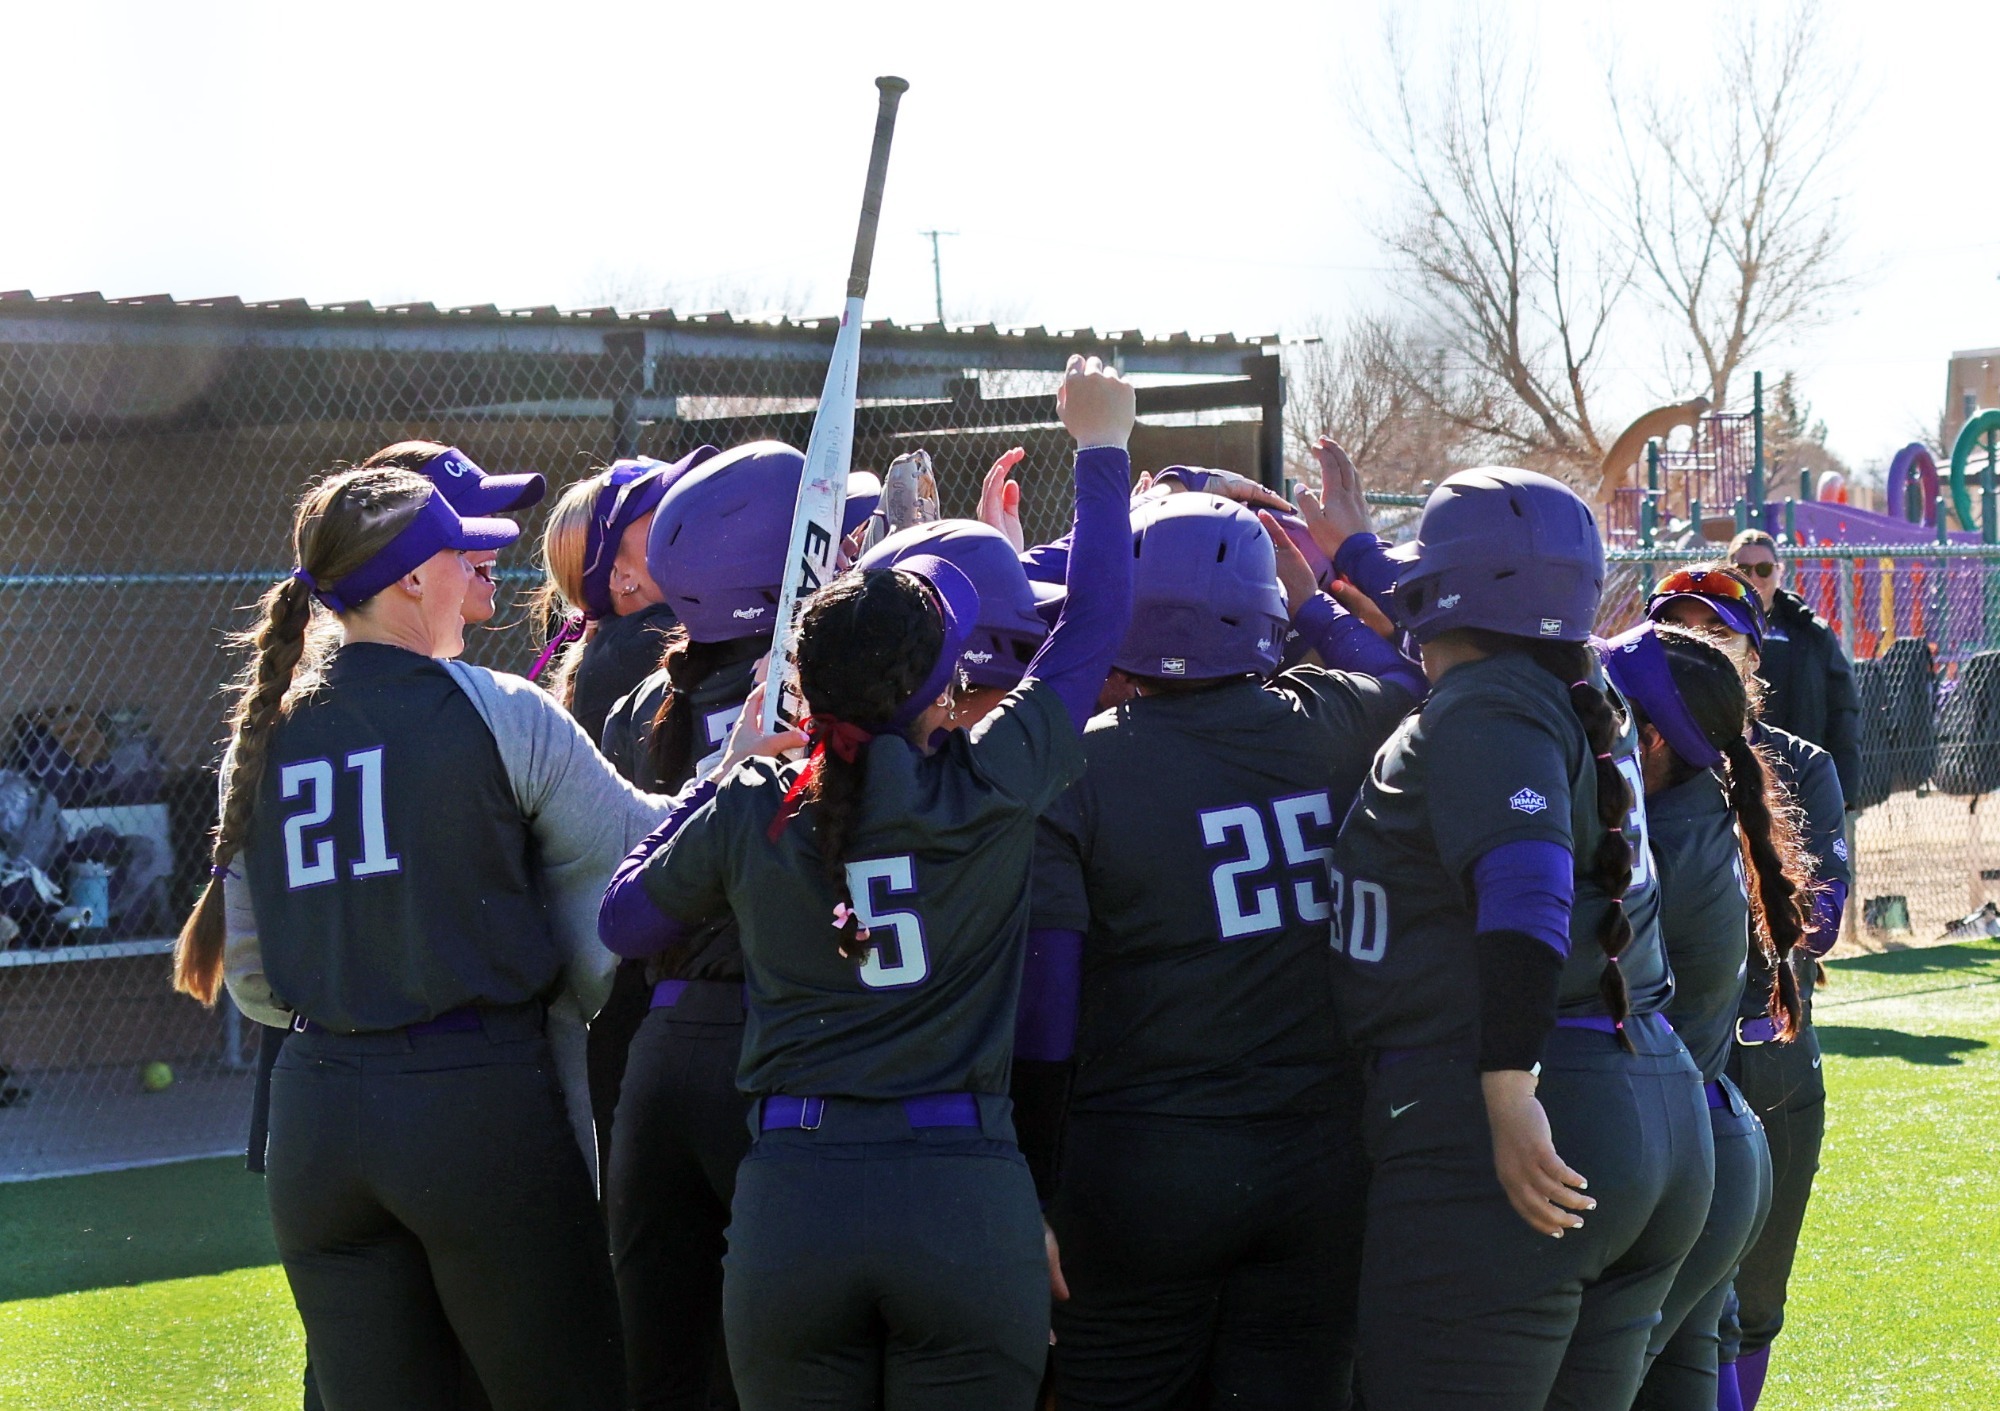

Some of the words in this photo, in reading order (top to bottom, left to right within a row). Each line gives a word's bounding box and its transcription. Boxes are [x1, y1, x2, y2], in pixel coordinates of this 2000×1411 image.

[280, 746, 401, 890] 21
[1199, 791, 1334, 940] 25
[1514, 797, 1544, 806] RMAC
[844, 854, 928, 989] 5
